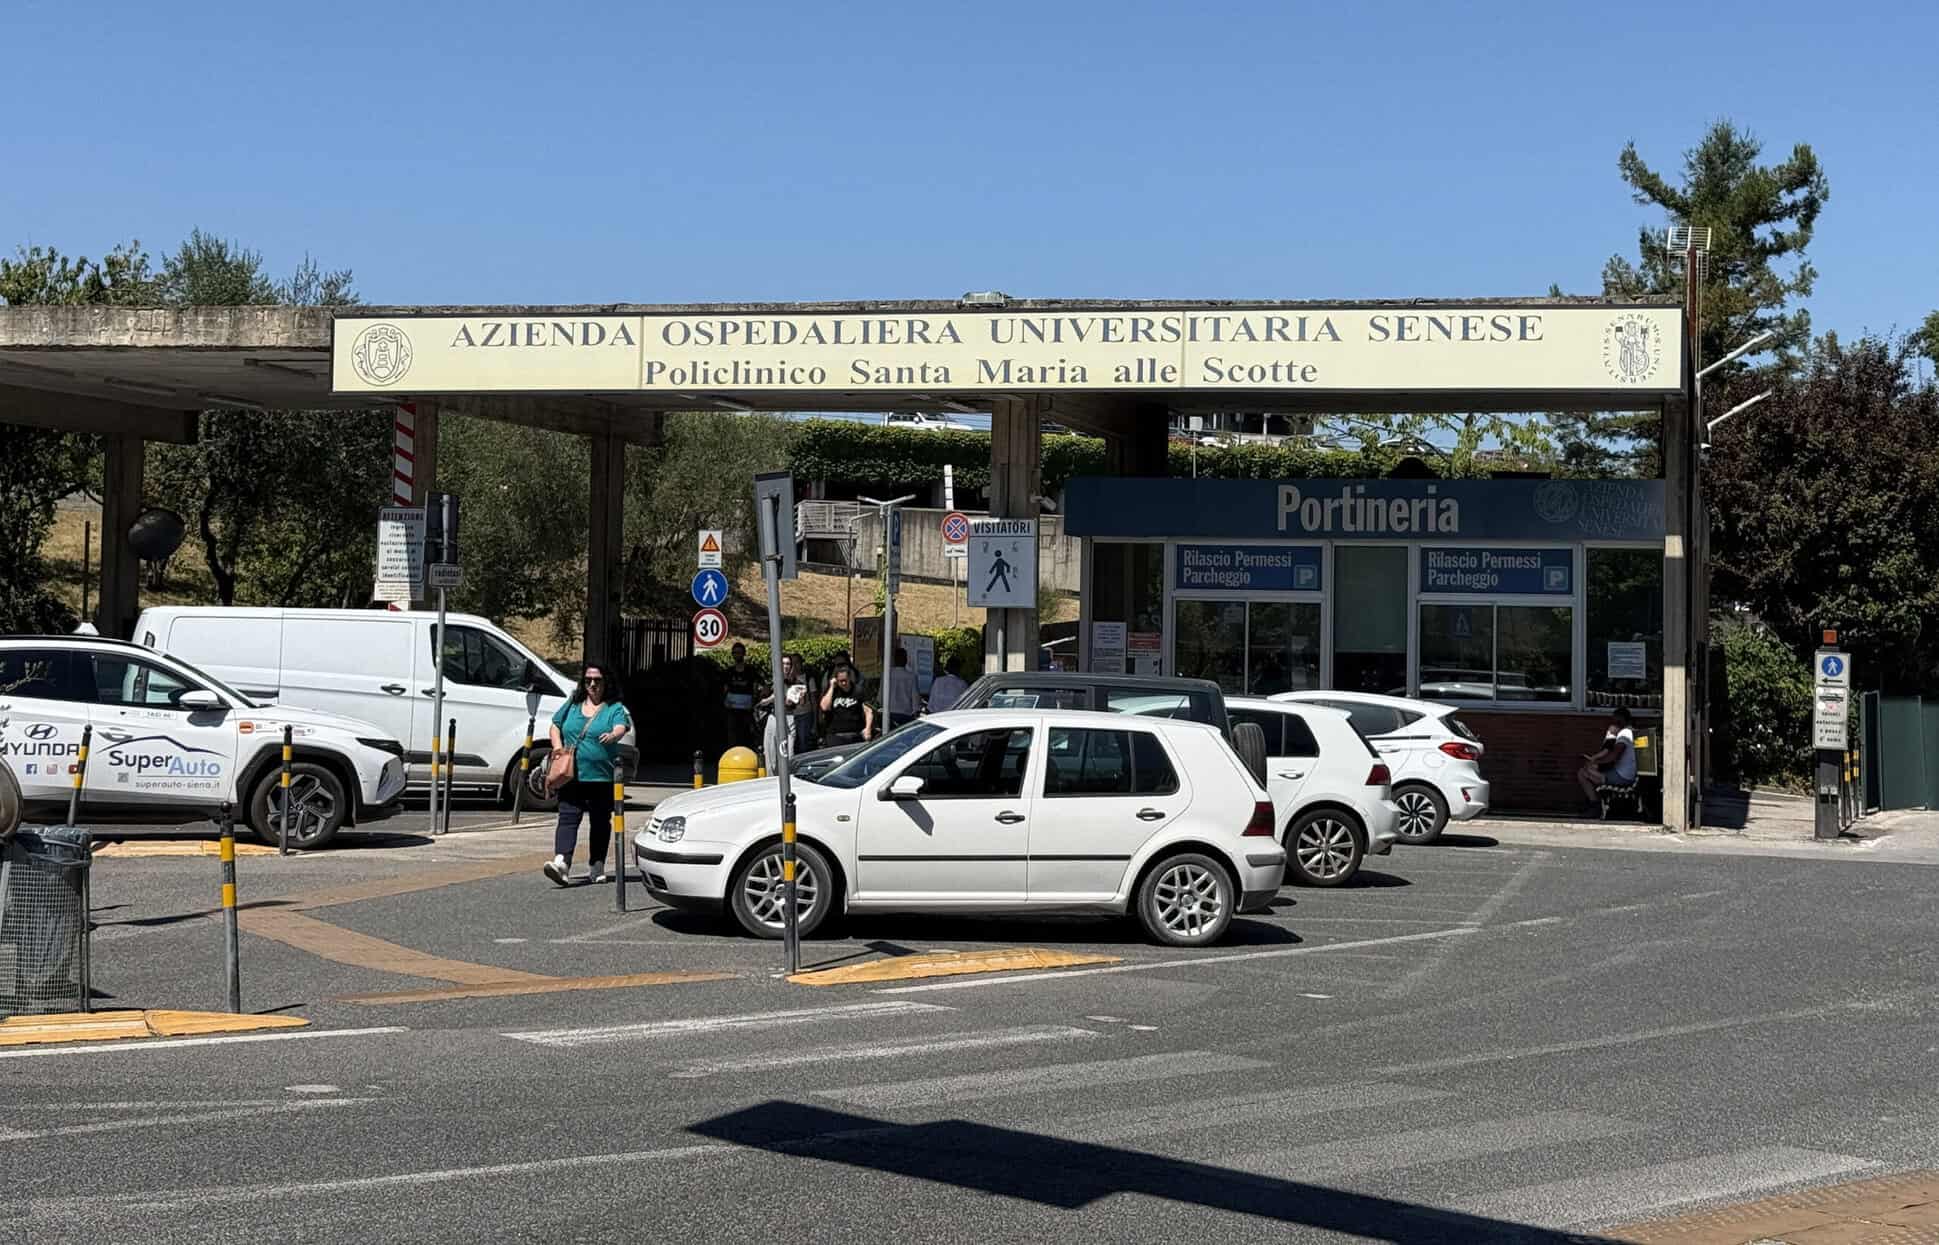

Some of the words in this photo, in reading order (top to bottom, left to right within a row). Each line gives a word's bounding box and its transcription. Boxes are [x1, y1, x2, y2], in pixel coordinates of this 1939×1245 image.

[449, 320, 636, 347] AZIENDA
[661, 317, 963, 347] OSPEDALIERA
[990, 314, 1342, 345] UNIVERSITARIA
[1368, 314, 1544, 342] SENESE
[645, 358, 827, 386] Policlinico
[850, 358, 951, 385] Santa
[976, 356, 1089, 385] Maria
[1113, 355, 1178, 384] alle
[1202, 355, 1318, 383] Scotte
[1277, 484, 1460, 532] Portineria
[973, 519, 1031, 535] VISITATORI
[1183, 550, 1231, 568] Rilascio
[1235, 551, 1292, 568] Permessi
[1428, 552, 1477, 569] Rilascio
[1482, 553, 1541, 570] Permessi
[1183, 567, 1251, 587] Parcheggio
[1301, 569, 1314, 585] P
[1428, 569, 1499, 589] Parcheggio
[1551, 571, 1564, 586] P
[699, 619, 719, 637] 30
[108, 750, 221, 775] SuperAuto
[135, 780, 221, 790] superauto-siena.it
